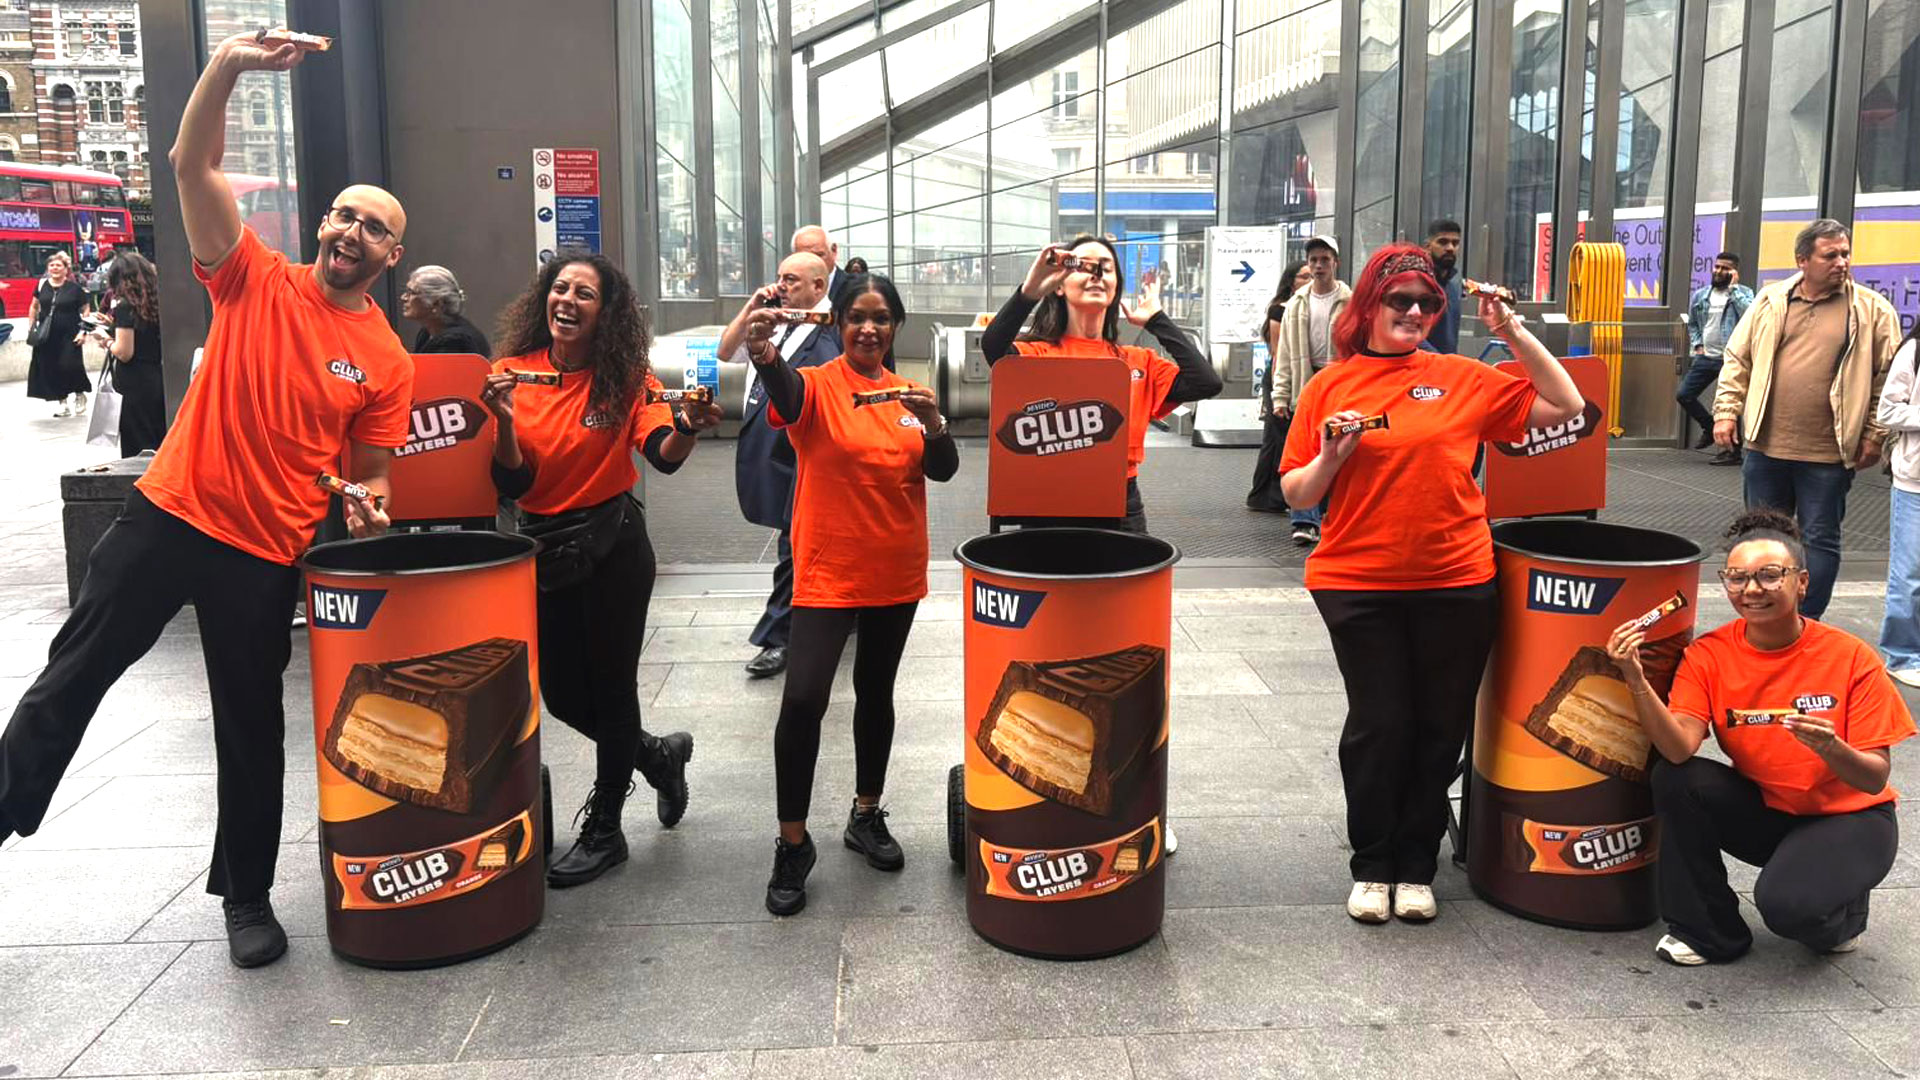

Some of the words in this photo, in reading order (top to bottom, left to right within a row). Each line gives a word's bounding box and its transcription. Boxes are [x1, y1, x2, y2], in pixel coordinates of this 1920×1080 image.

[331, 361, 362, 380] CLUB
[406, 403, 467, 442] UB
[1014, 405, 1104, 446] CLUB
[394, 435, 457, 457] LAYERS
[1036, 437, 1094, 456] LAYERS
[1527, 434, 1577, 456] LAYERS
[1534, 575, 1596, 609] NEW
[313, 590, 359, 624] NEW
[975, 586, 1020, 623] NEW
[1796, 695, 1833, 709] CLUB
[1544, 830, 1561, 839] NEW
[1573, 825, 1642, 864] CLUB
[993, 852, 1008, 862] NEW
[1593, 850, 1637, 870] LAYERS
[347, 864, 362, 873] NEW
[372, 852, 449, 897] CLUB
[1017, 852, 1088, 889] CLUB
[394, 879, 444, 903] LAYERS
[1036, 878, 1083, 897] LAYERS
